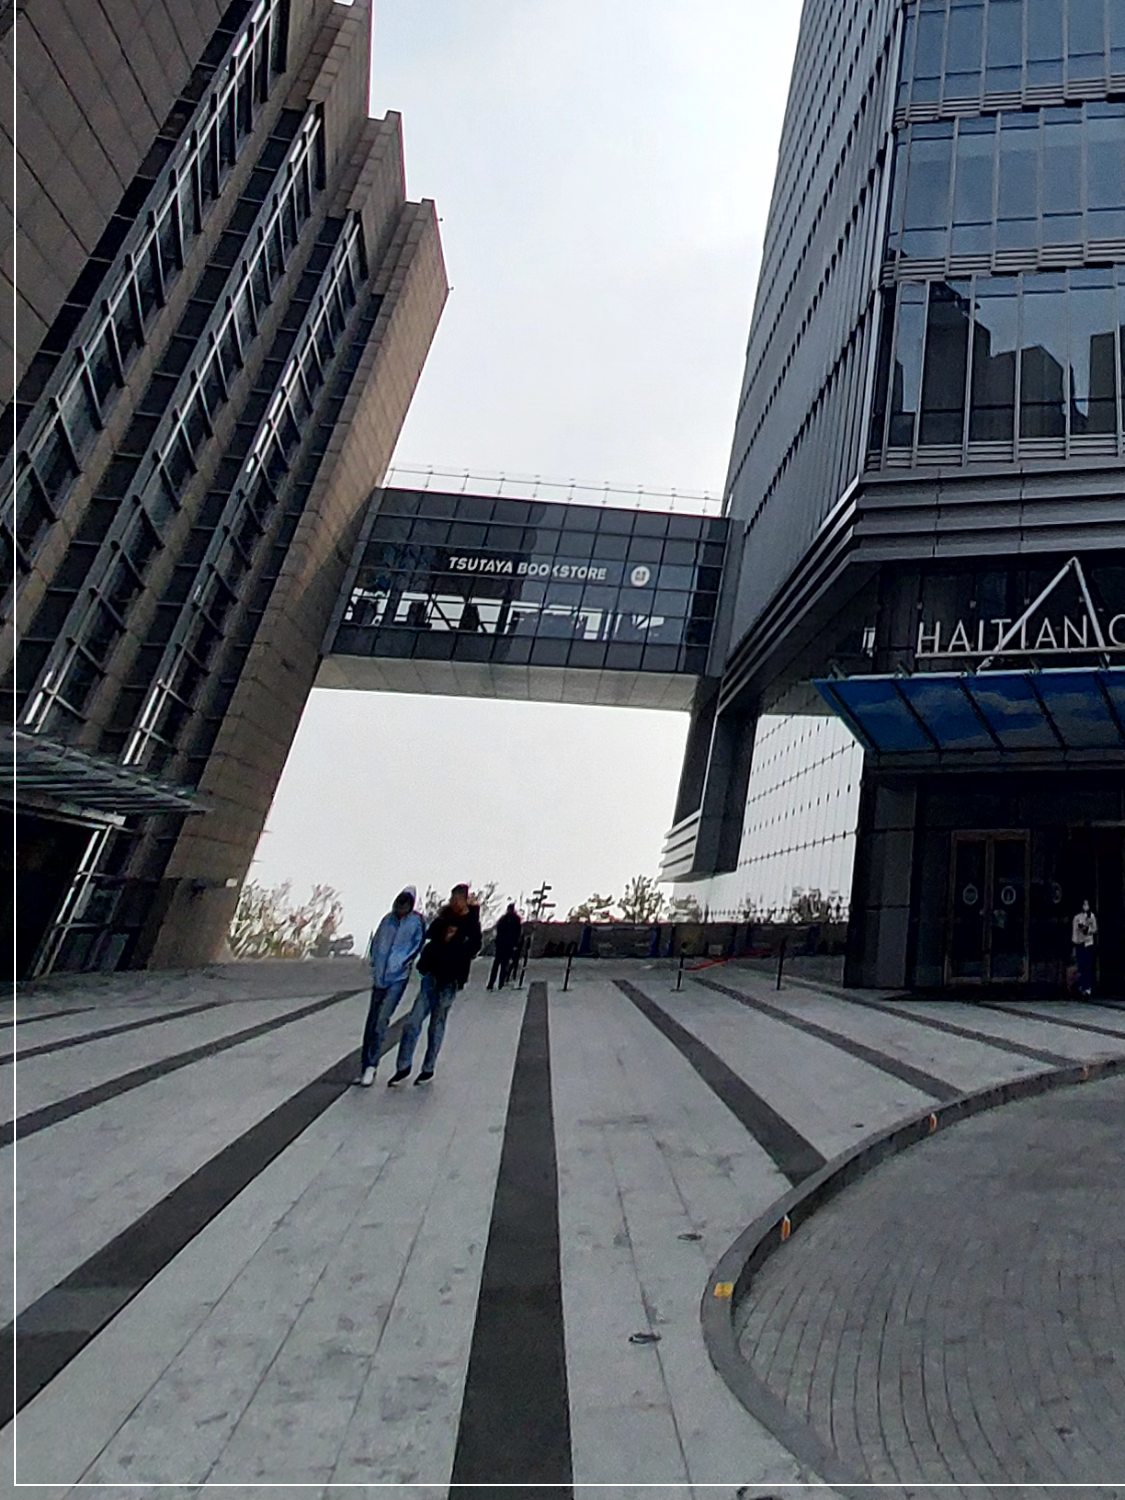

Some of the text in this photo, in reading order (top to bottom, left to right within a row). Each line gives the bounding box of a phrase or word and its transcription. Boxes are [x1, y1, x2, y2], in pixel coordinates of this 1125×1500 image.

[449, 556, 608, 581] TSUTAYA BOOKSTORE
[916, 614, 1089, 653] HAITIAN
